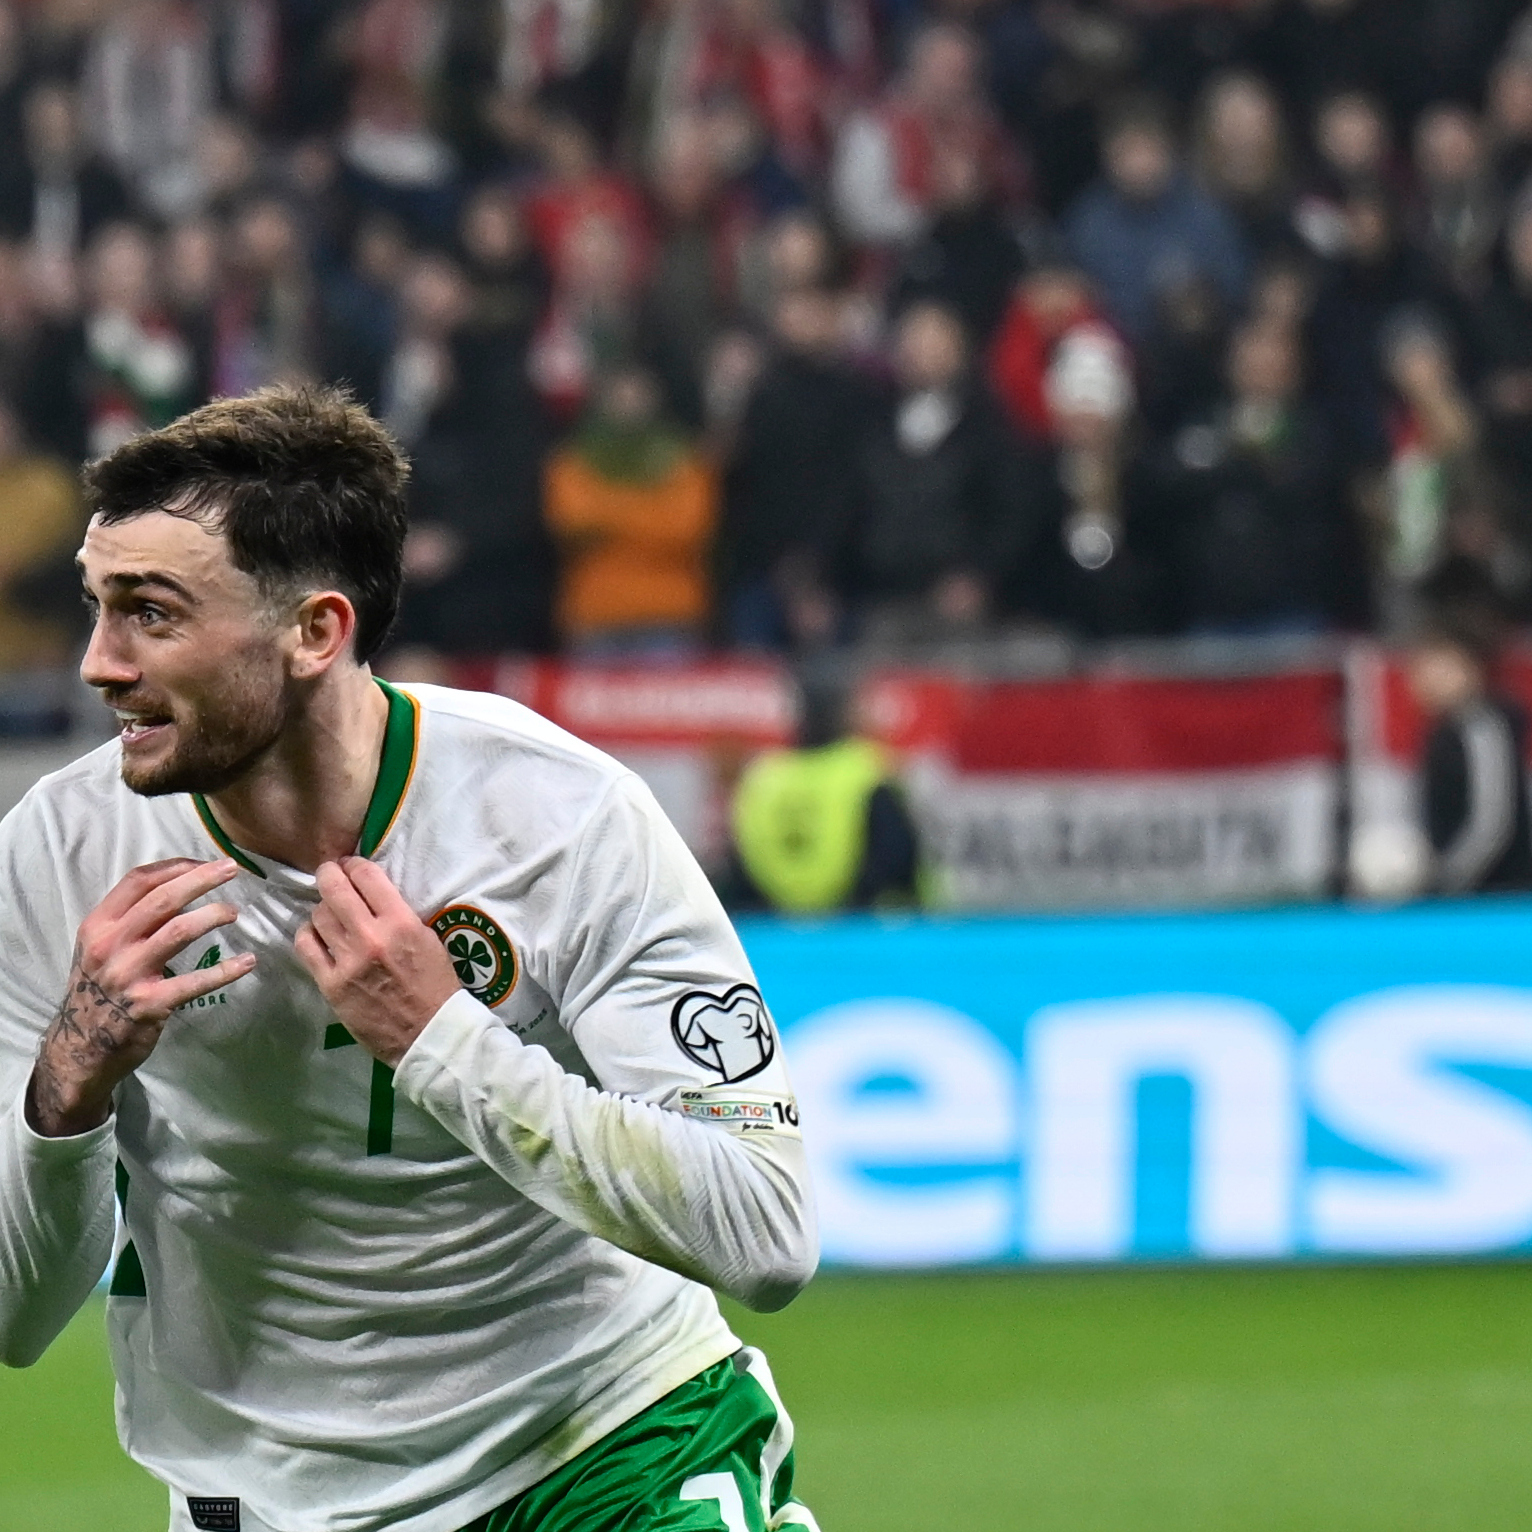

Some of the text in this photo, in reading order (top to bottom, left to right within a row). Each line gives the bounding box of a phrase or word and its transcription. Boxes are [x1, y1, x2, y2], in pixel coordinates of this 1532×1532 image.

[436, 911, 496, 937] ELAND
[680, 1091, 703, 1100] UEFA
[682, 1104, 772, 1118] FOUNDATION
